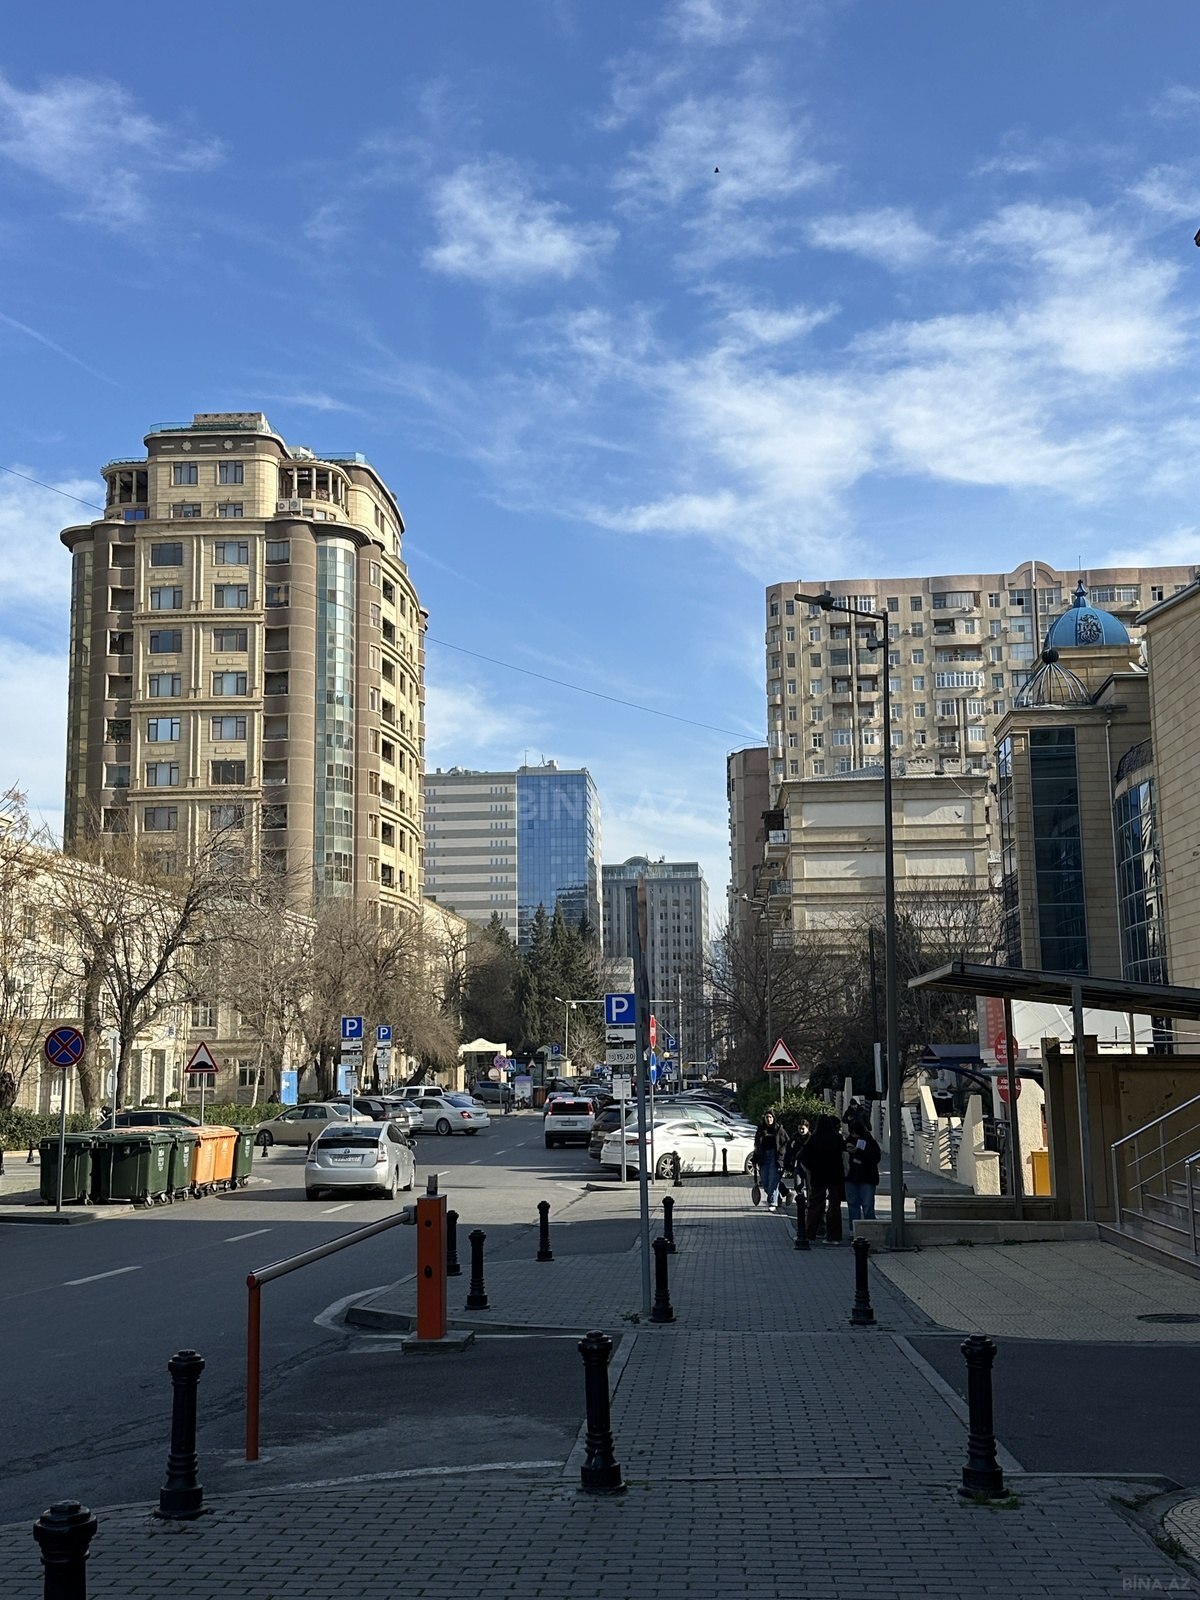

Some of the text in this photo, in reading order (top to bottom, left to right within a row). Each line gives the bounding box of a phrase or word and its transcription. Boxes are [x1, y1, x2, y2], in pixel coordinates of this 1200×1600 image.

[611, 997, 629, 1022] P
[346, 1019, 358, 1036] P
[380, 1027, 388, 1039] P
[553, 1046, 559, 1054] P
[668, 1039, 675, 1049] P
